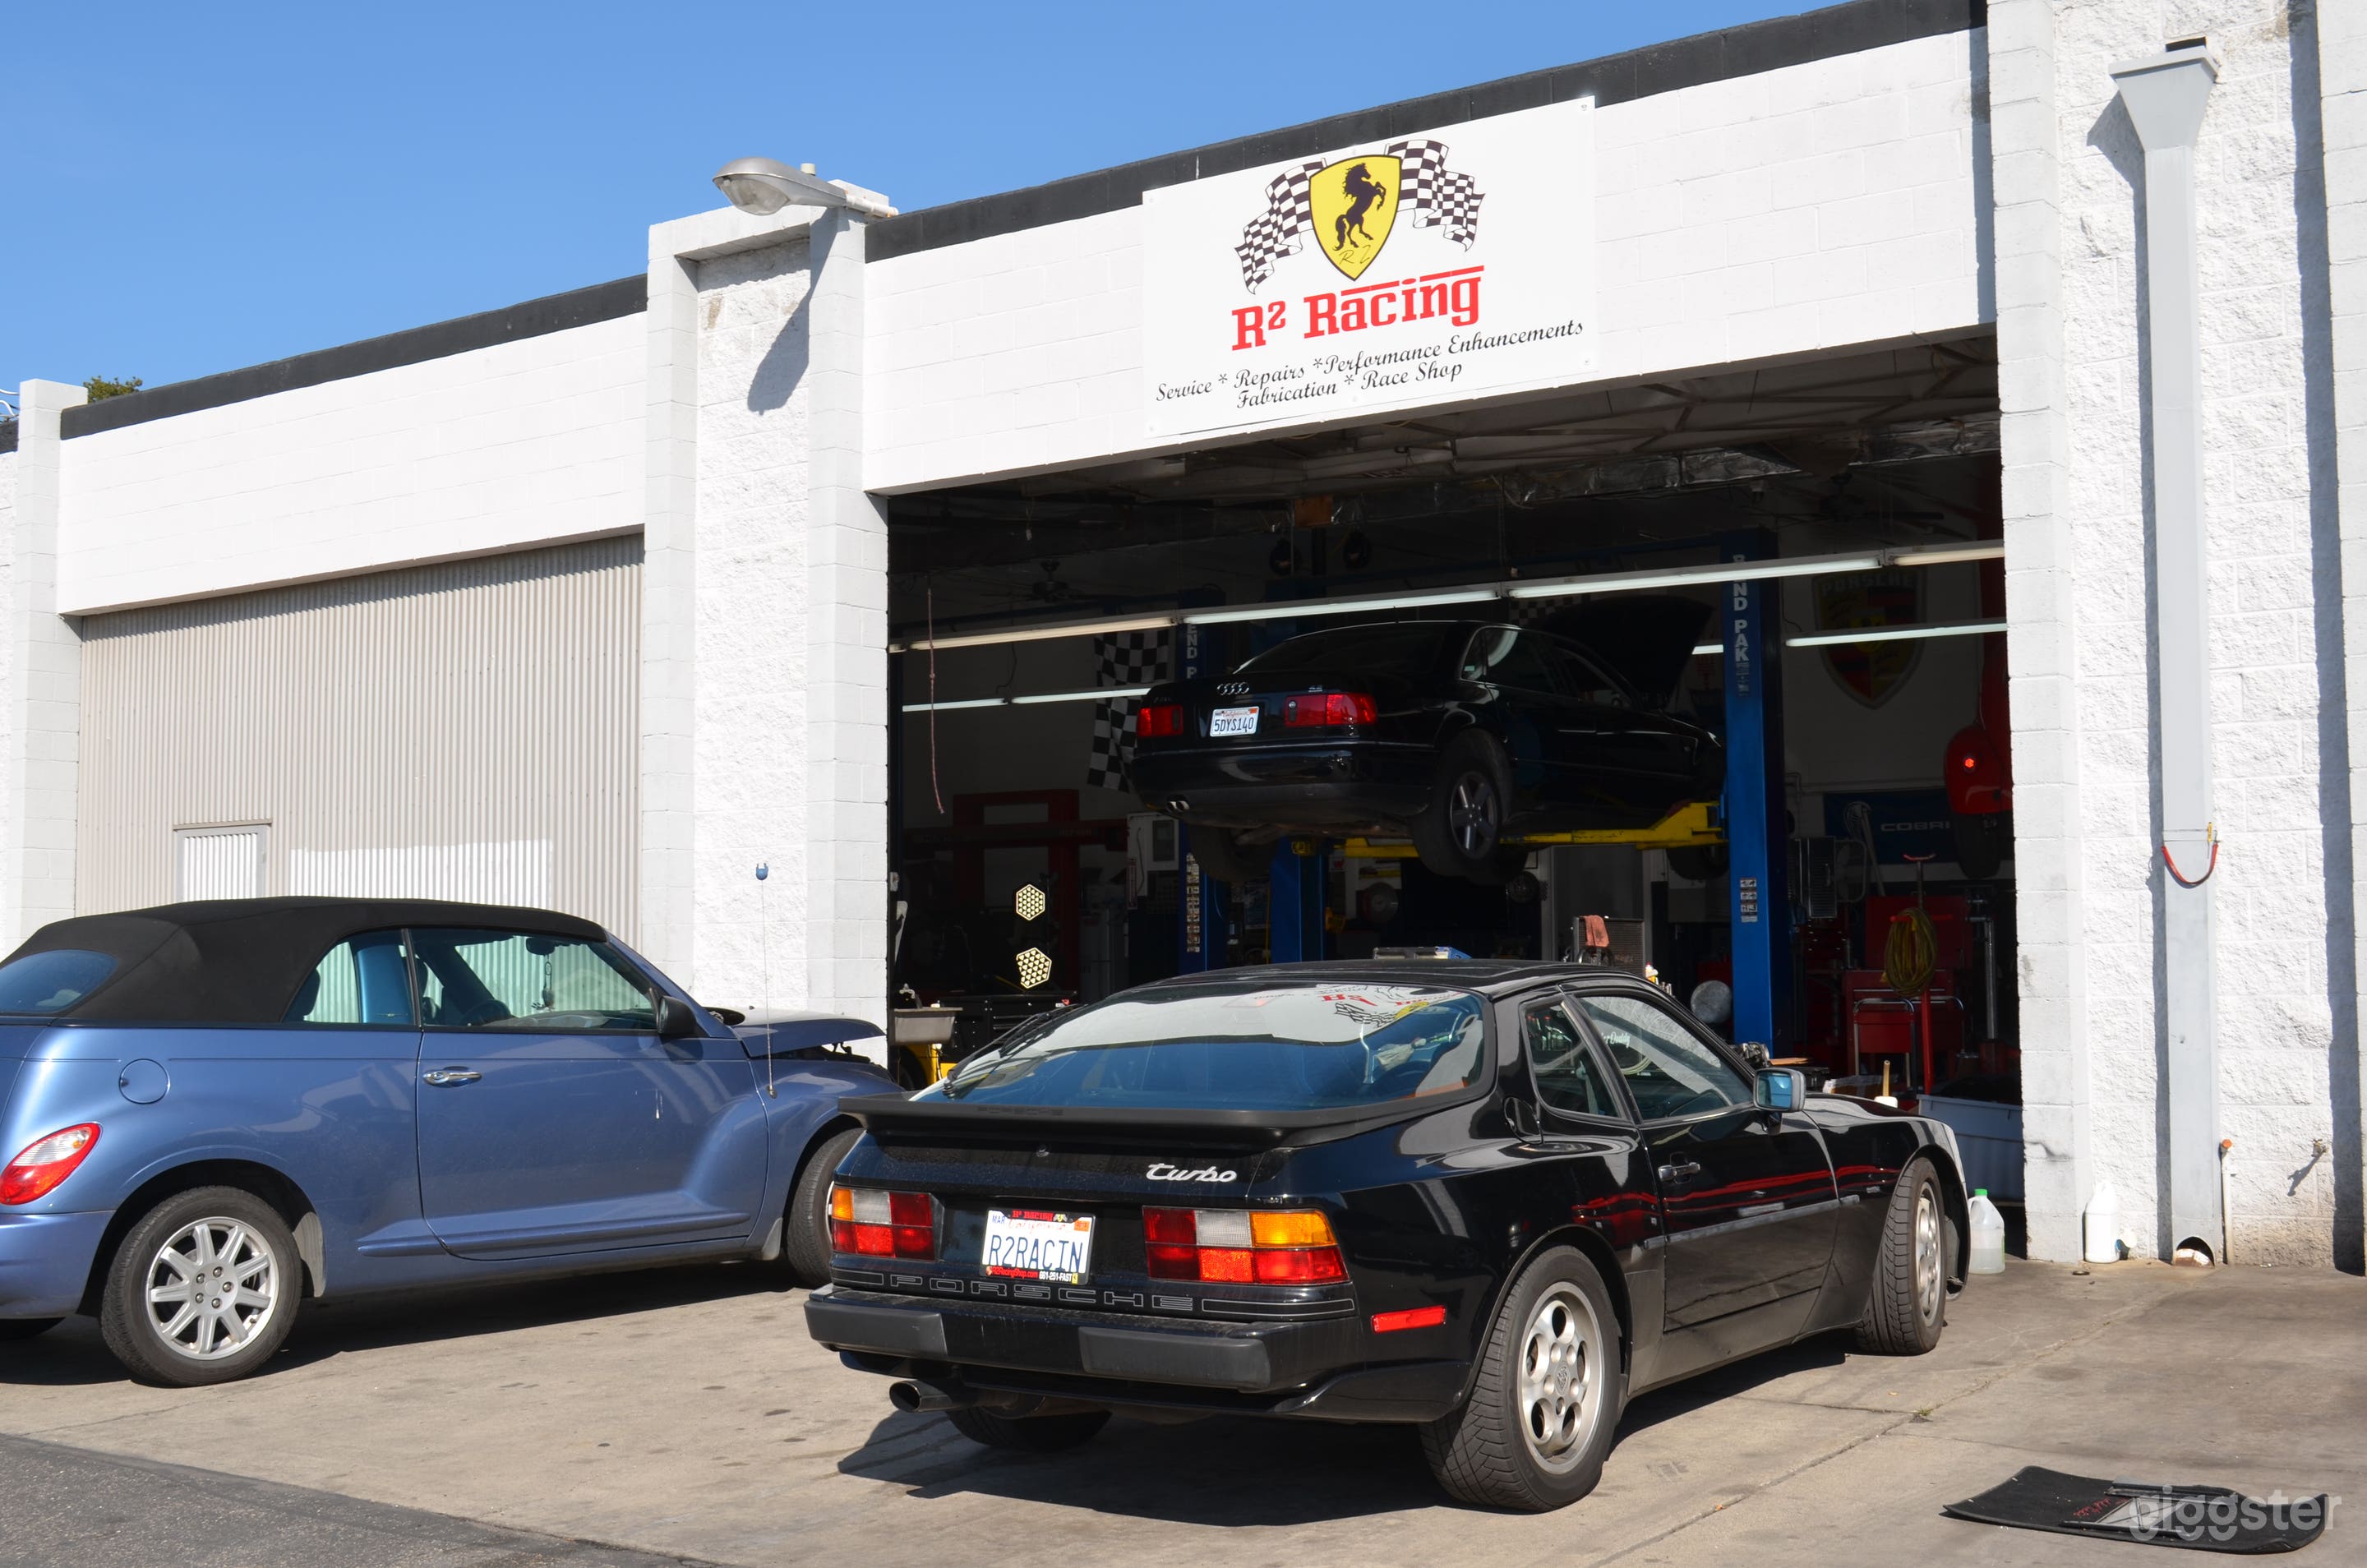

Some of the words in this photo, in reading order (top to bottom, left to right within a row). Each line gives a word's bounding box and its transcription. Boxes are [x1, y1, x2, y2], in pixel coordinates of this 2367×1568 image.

[1303, 265, 1484, 339] Racing
[1156, 380, 1213, 401] Service
[1234, 365, 1305, 390] Repairs
[1448, 319, 1584, 355] Enhancements
[1236, 381, 1338, 408] Fabrication
[1361, 369, 1409, 390] Race
[1415, 361, 1463, 383] Shop
[1734, 619, 1749, 662] PAK
[1214, 717, 1254, 733] 5DYS140
[991, 1215, 1006, 1224] MAR
[989, 1234, 1082, 1273] R2RACIN
[890, 1273, 1193, 1311] PORSCHE
